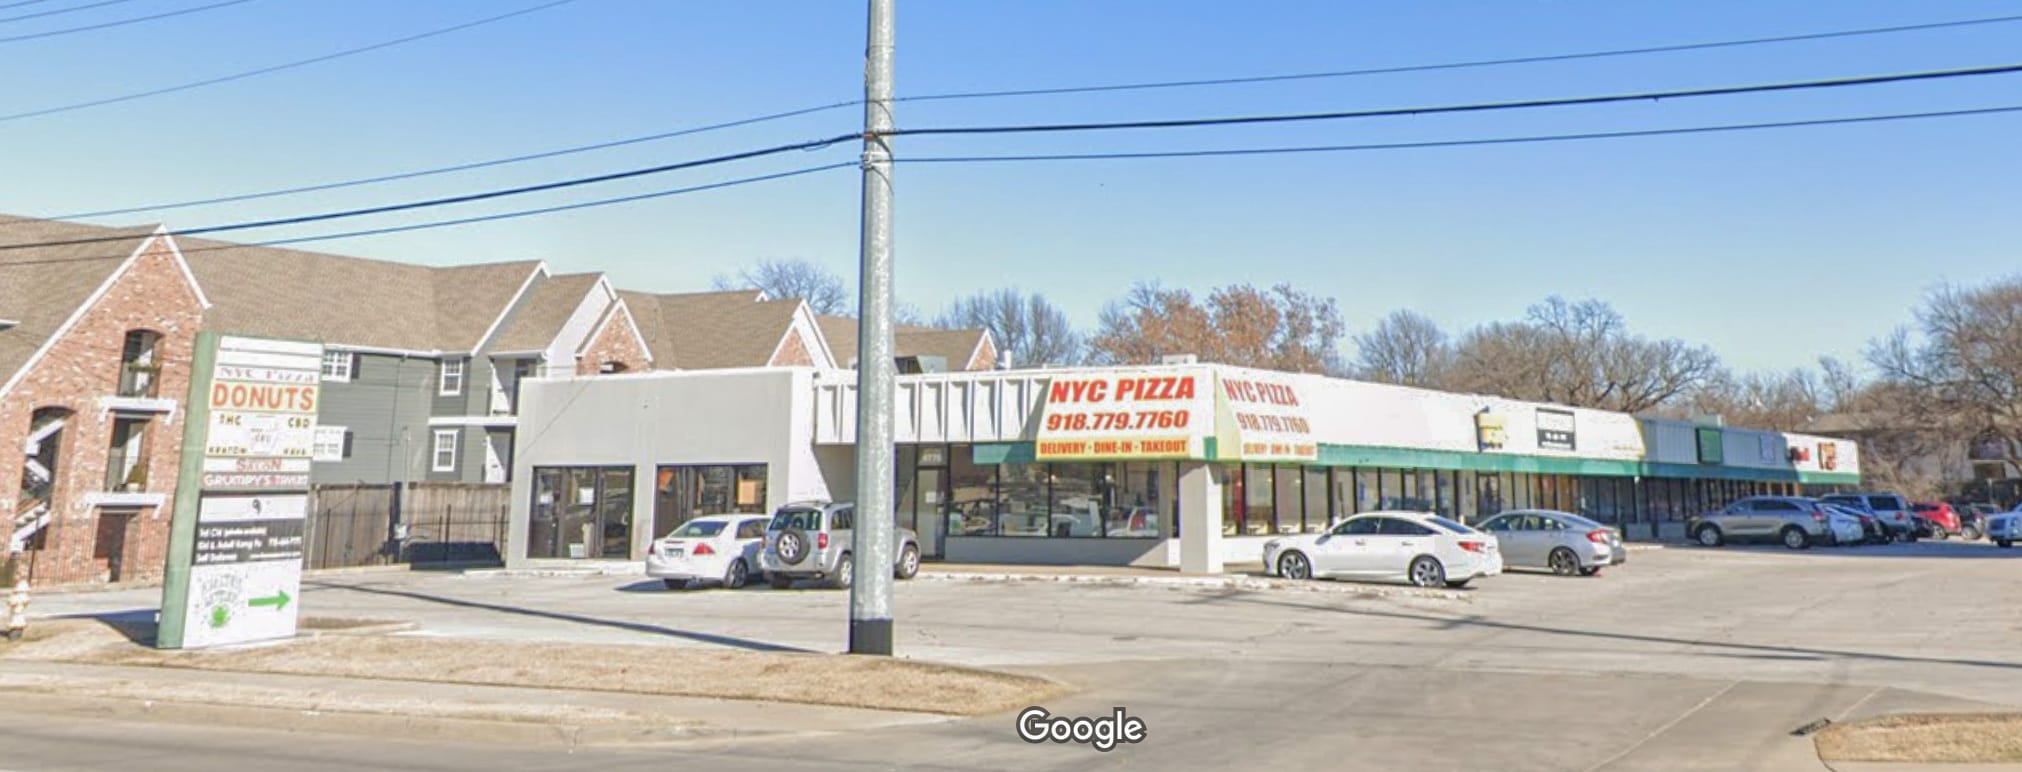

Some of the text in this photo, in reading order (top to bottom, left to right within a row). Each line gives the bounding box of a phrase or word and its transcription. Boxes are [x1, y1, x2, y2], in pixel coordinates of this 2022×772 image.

[212, 383, 315, 410] DONUTS
[1049, 376, 1195, 403] NYC PIZZA
[1222, 378, 1299, 406] NYC PIZZA
[219, 414, 310, 428] THC CBD
[1046, 410, 1189, 431] 918.779.7760
[1040, 440, 1187, 454] DELIVERY DINE-IN TAKEOUT
